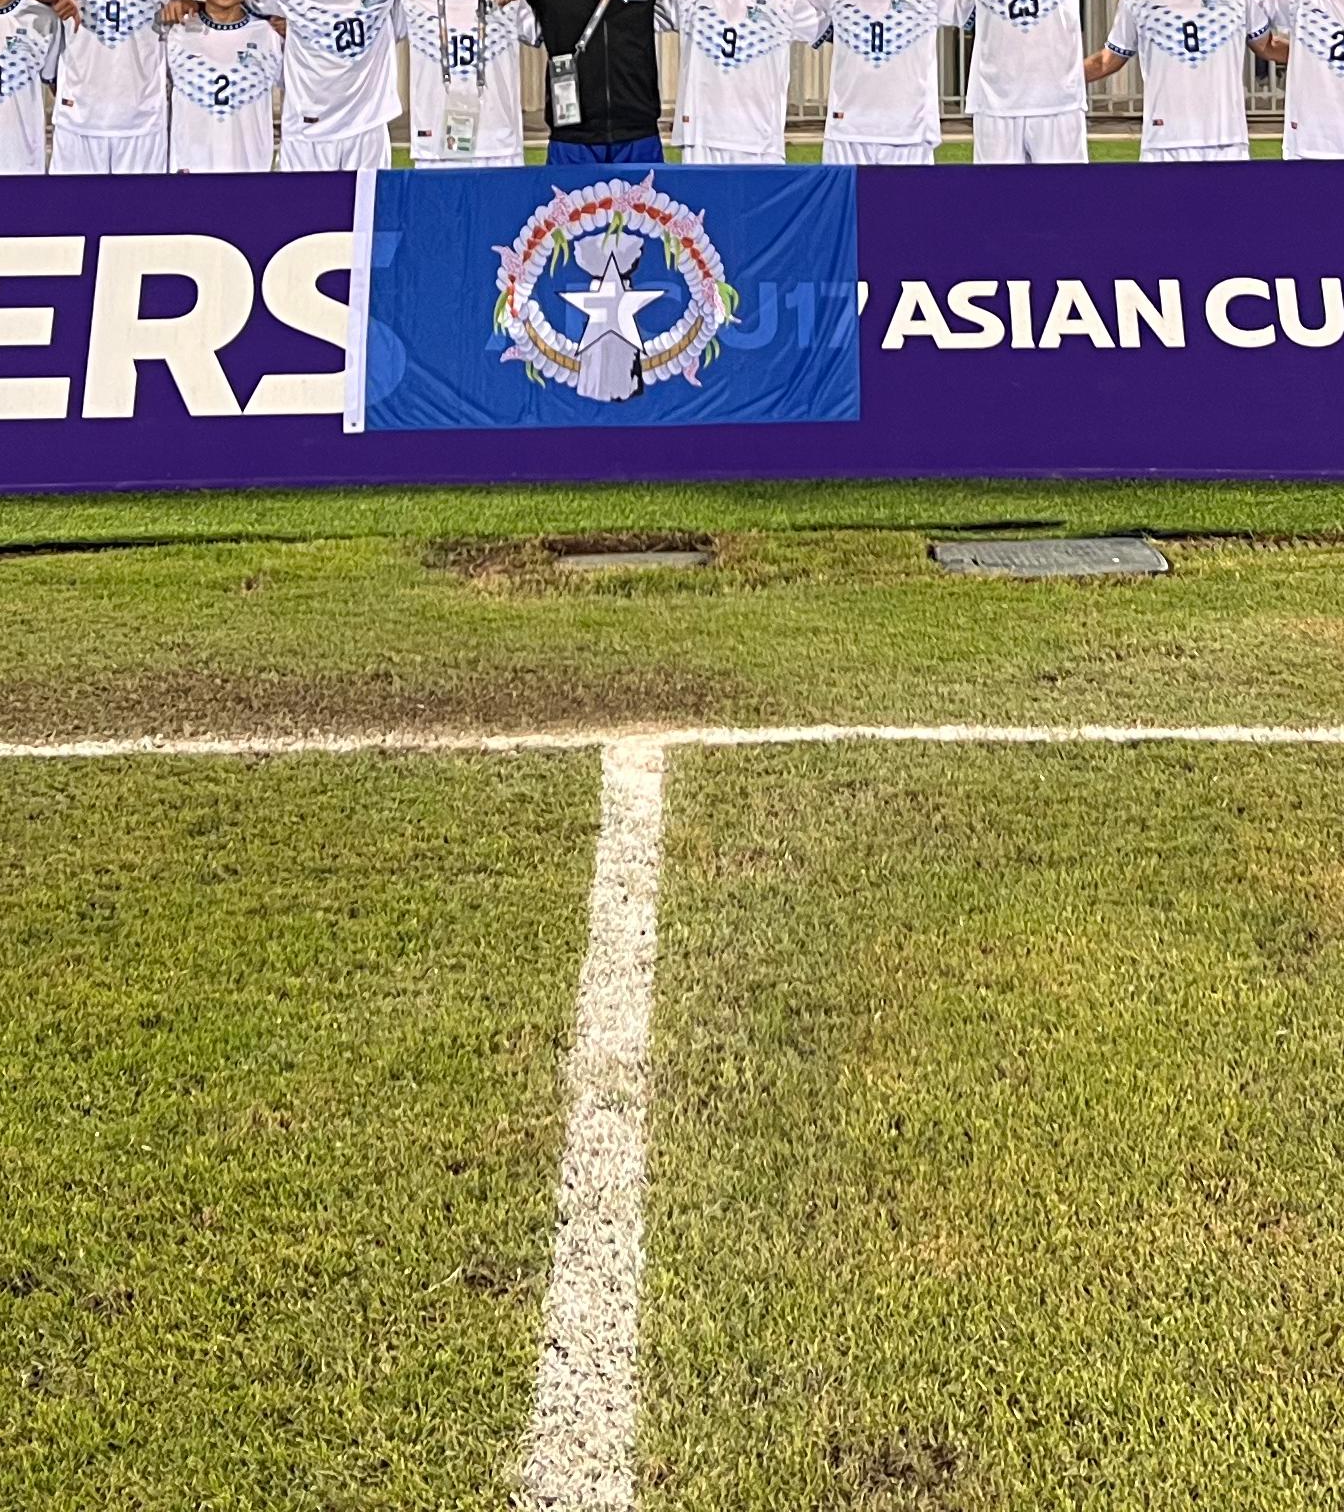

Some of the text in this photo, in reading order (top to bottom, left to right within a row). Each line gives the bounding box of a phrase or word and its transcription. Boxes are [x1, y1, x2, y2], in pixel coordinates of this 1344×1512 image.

[333, 17, 365, 53] 20
[451, 34, 474, 67] 13
[721, 27, 737, 59] 9
[1183, 21, 1200, 53] 8
[214, 74, 230, 106] 2
[881, 279, 1186, 349] ASIAN
